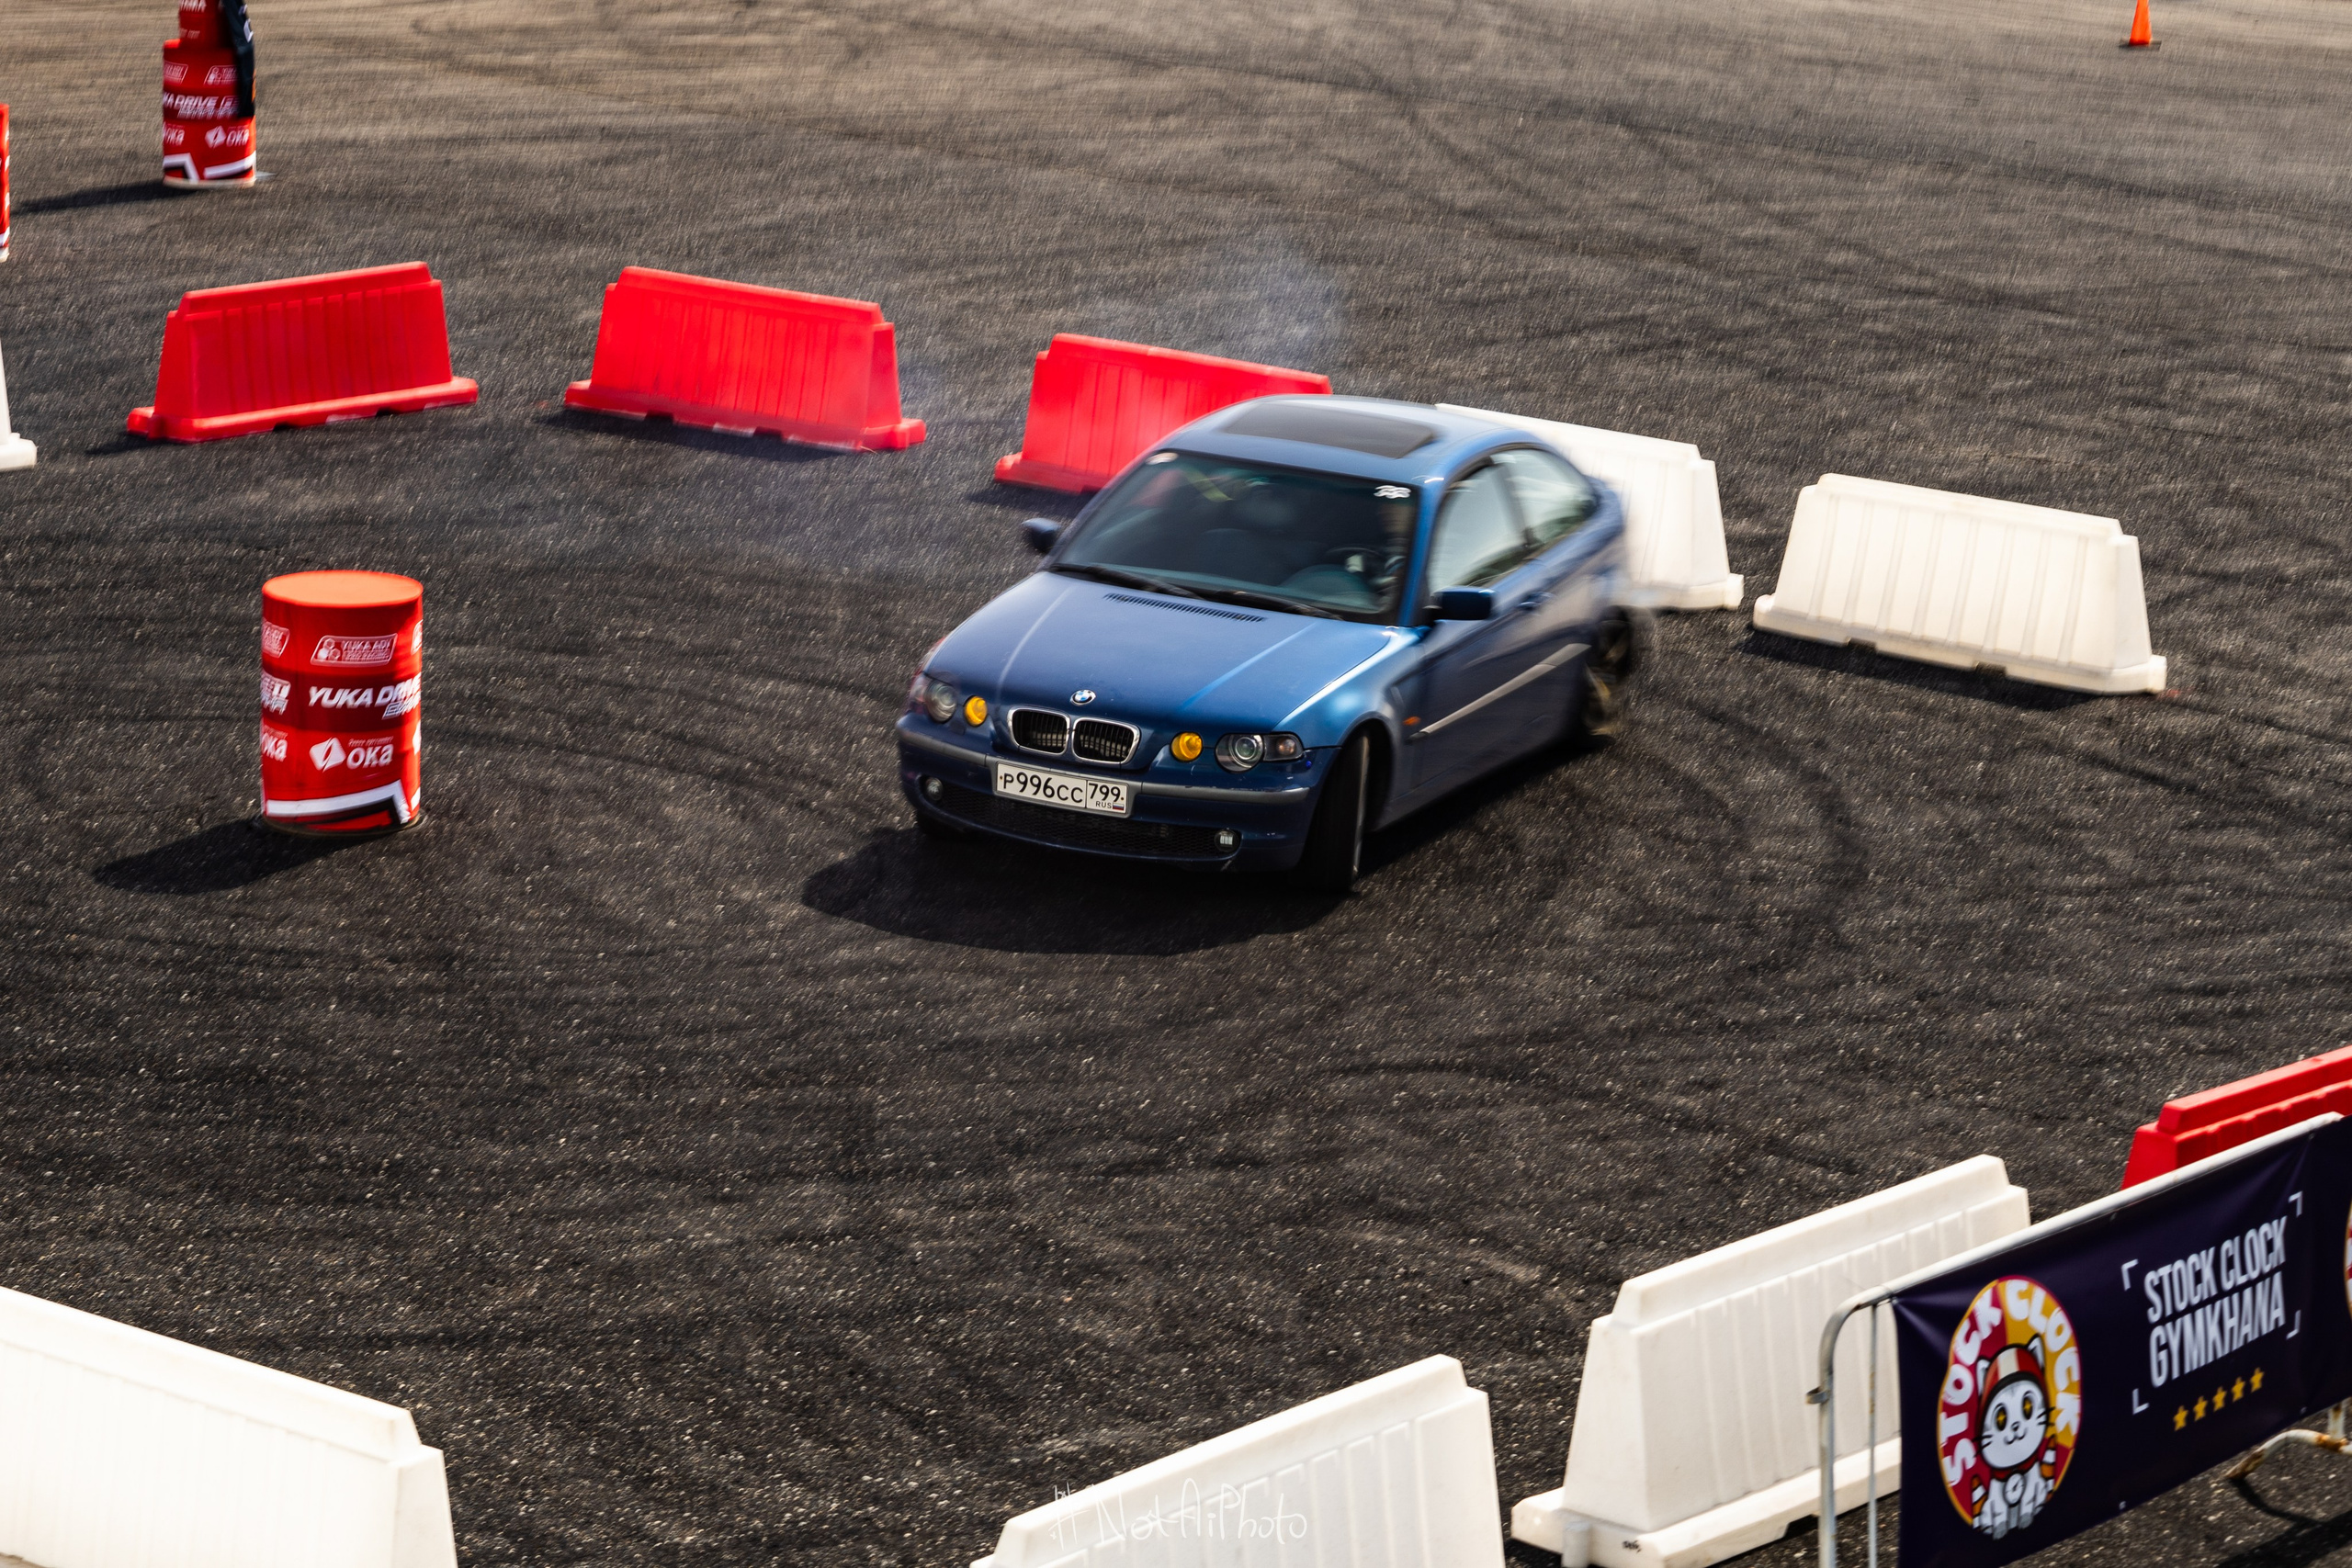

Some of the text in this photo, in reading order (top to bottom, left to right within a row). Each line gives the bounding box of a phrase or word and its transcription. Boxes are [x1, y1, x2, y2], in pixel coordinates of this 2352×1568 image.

[309, 686, 373, 709] YUKA
[1088, 783, 1121, 803] 799
[1095, 800, 1113, 809] RUS
[2143, 1215, 2288, 1325] STOCK CLOCK
[2149, 1270, 2287, 1388] GYMKHANA
[1939, 1278, 2081, 1487] STOCK CLOCK
